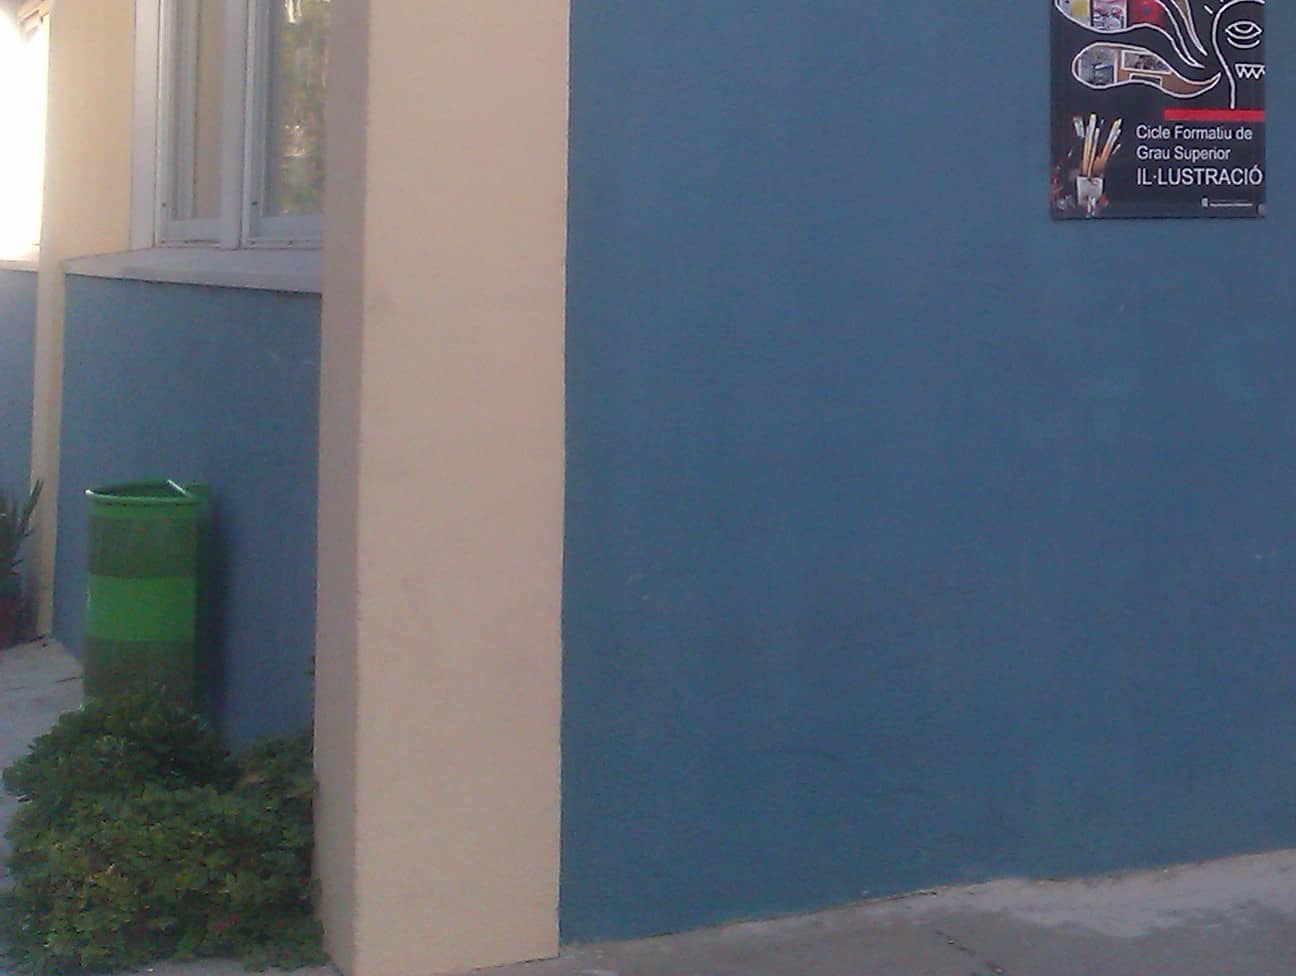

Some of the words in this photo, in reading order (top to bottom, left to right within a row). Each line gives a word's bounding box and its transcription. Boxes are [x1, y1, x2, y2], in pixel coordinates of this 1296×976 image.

[1136, 125, 1170, 139] Cicle
[1174, 125, 1232, 140] Formatiu
[1235, 126, 1252, 140] de
[1136, 145, 1170, 160] Grau
[1174, 146, 1231, 162] Superior
